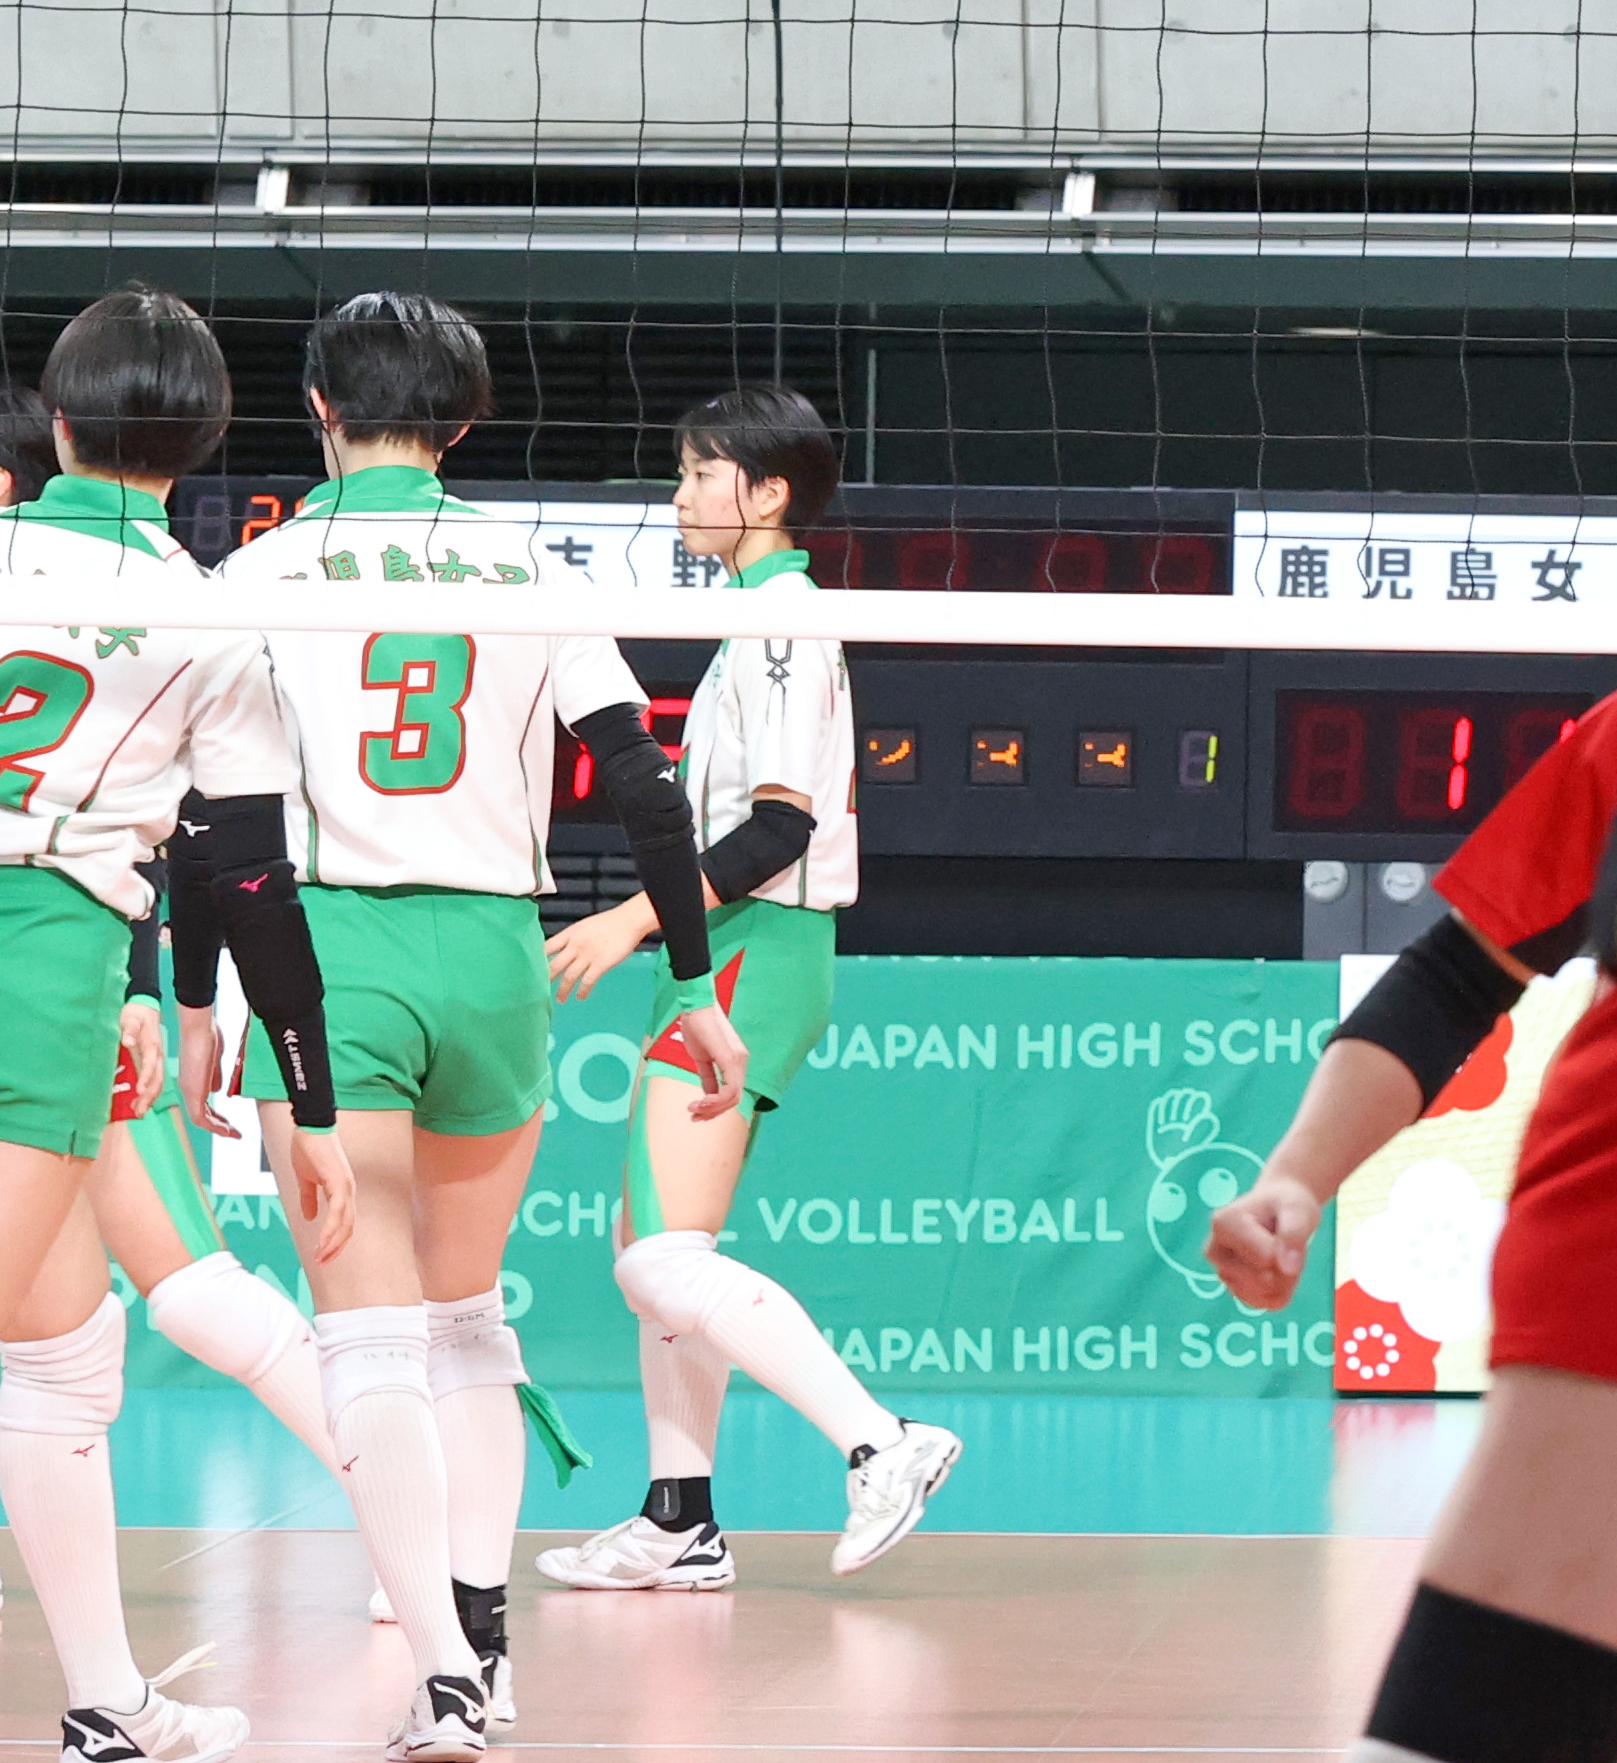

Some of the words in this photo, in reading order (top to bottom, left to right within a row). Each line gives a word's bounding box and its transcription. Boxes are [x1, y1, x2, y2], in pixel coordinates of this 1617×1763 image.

[1277, 543, 1583, 602] 鹿児島女
[358, 631, 477, 796] 3
[806, 1022, 997, 1071] JAPAN
[1016, 1021, 1161, 1070] HIGH
[756, 1197, 1126, 1245] VOLLEYBALL
[826, 1327, 993, 1373] APAN
[1012, 1324, 1158, 1372] HIGH
